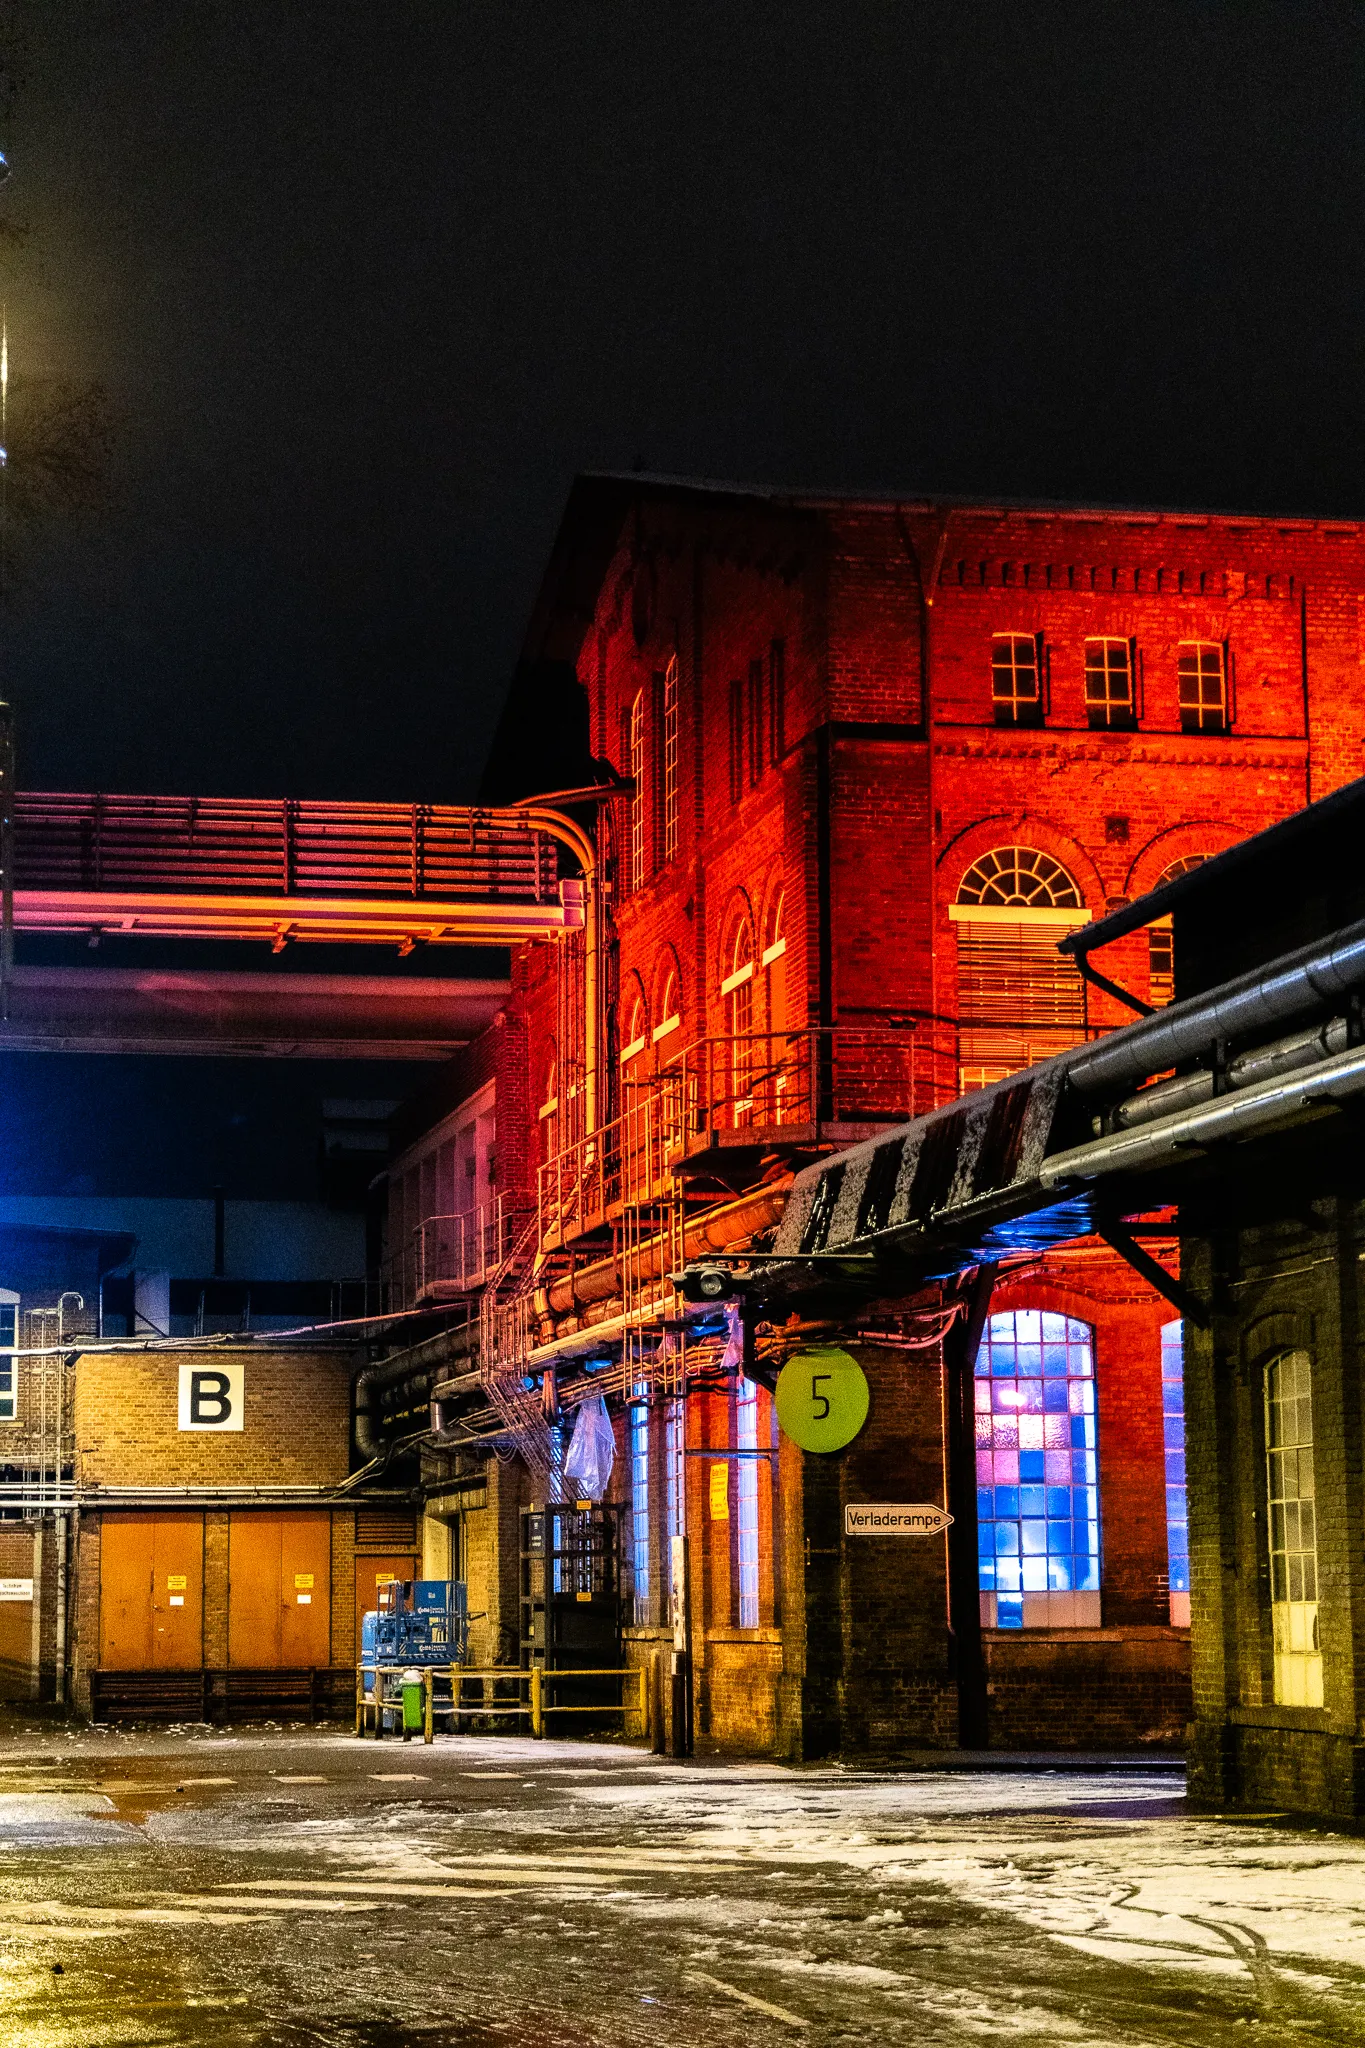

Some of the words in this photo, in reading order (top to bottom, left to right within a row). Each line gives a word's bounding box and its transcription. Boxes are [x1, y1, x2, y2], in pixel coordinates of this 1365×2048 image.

[190, 1371, 232, 1424] B
[811, 1375, 831, 1420] 5
[849, 1512, 941, 1529] Verladerampe
